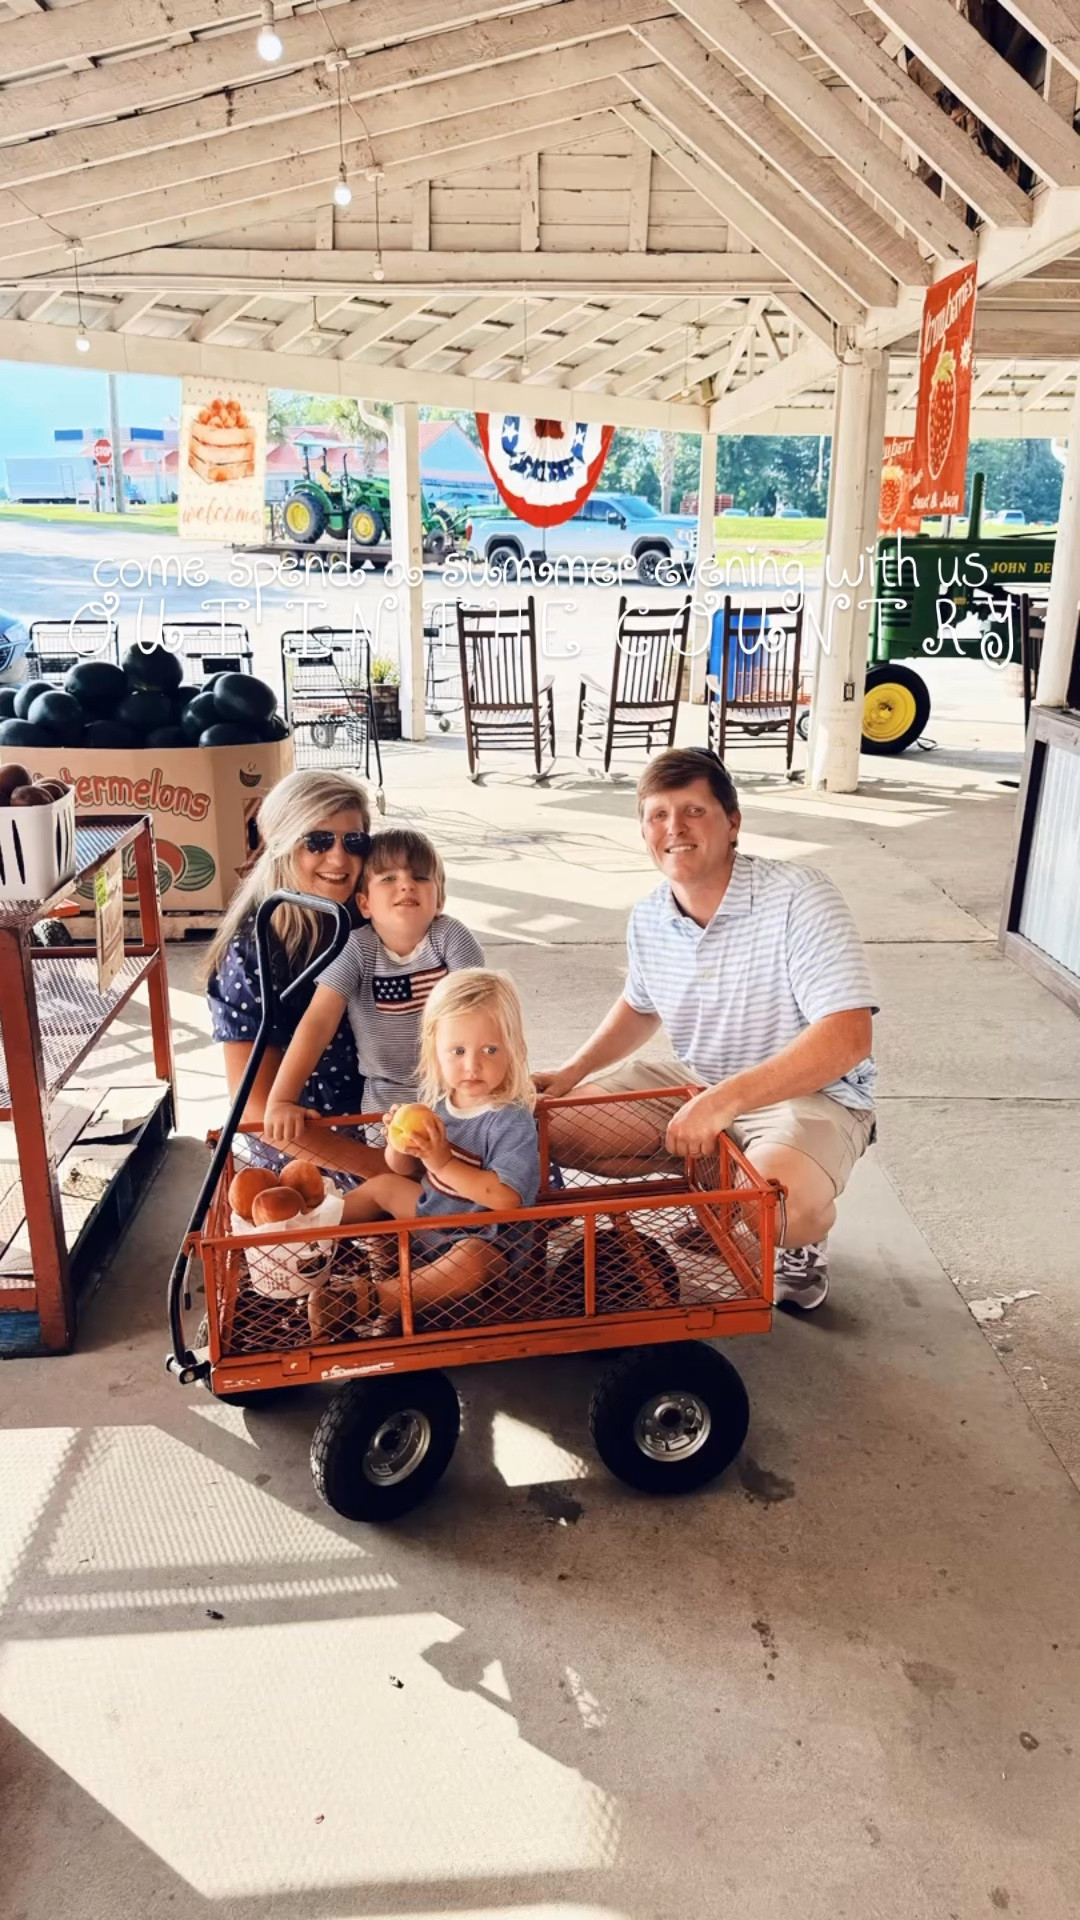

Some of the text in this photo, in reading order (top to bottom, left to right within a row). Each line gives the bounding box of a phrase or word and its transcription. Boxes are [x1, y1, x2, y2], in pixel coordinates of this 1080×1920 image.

[95, 446, 112, 457] STOP
[182, 496, 262, 525] welcome
[990, 562, 1052, 574] JOHN DE
[33, 768, 211, 821] ermelons
